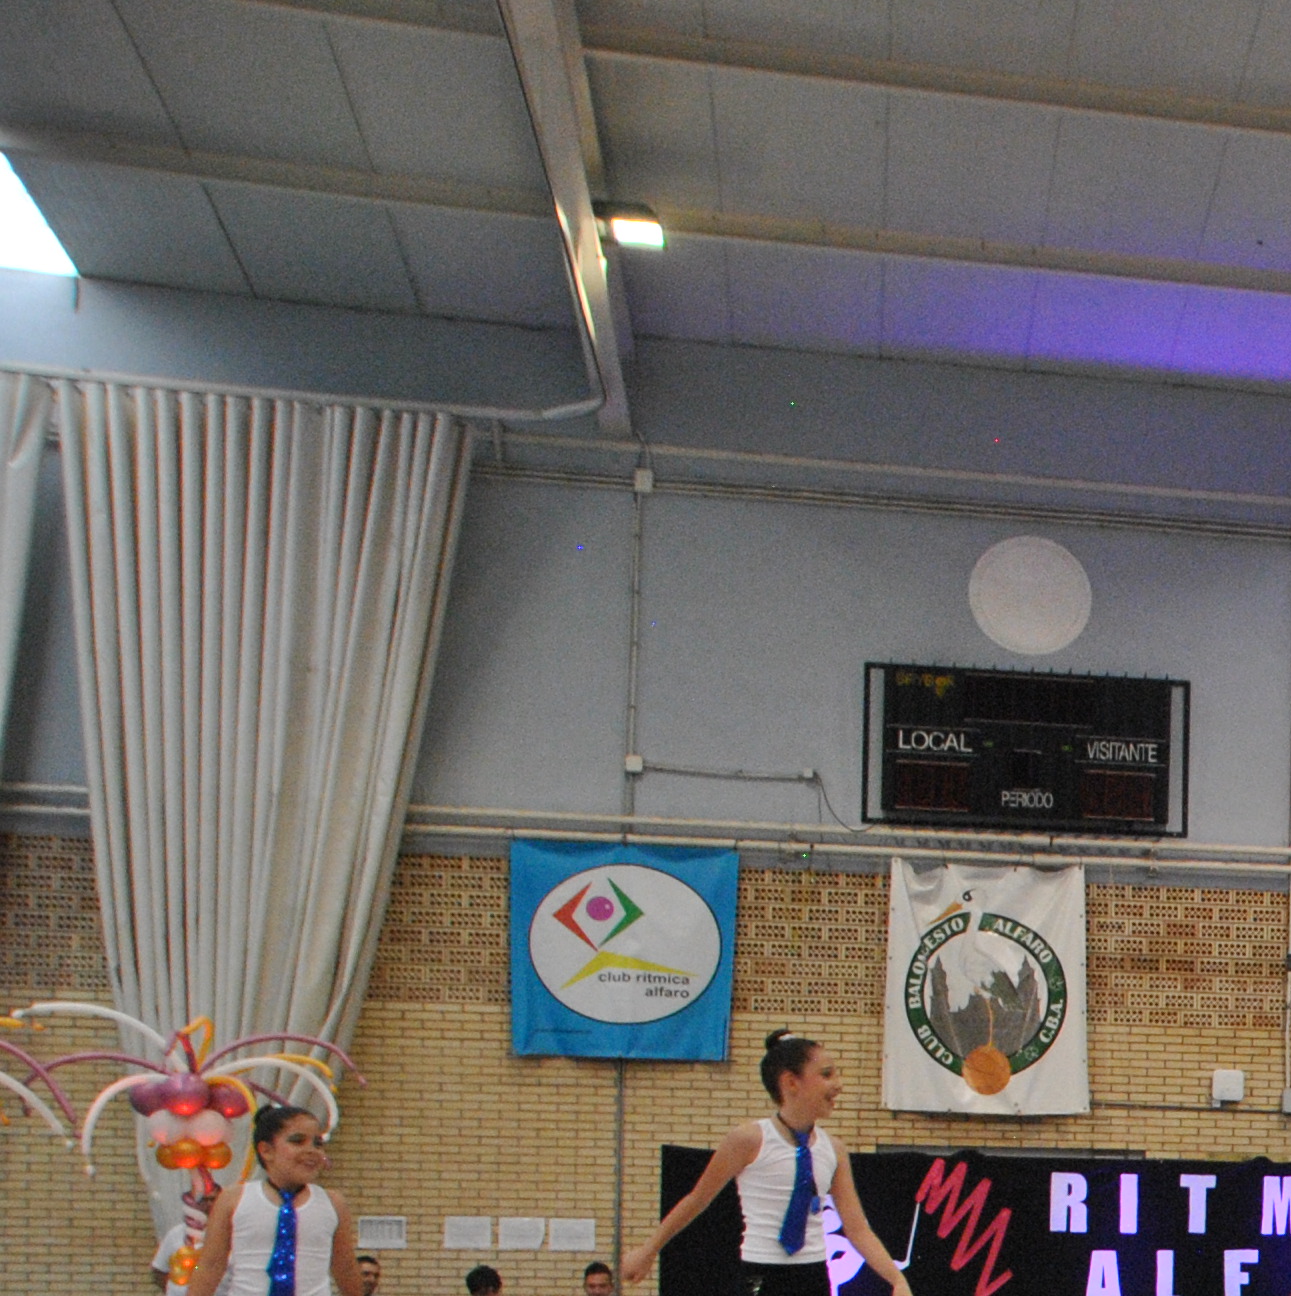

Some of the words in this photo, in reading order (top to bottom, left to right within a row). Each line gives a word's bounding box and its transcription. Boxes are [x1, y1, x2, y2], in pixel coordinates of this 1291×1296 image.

[899, 730, 973, 752] LOCAL
[1087, 742, 1158, 762] VISITANTE
[993, 918, 1053, 963] ALFARO
[908, 916, 964, 1009] BALOESTO
[598, 972, 631, 983] club
[645, 986, 690, 998] alfaro
[917, 1024, 954, 1066] CLUB
